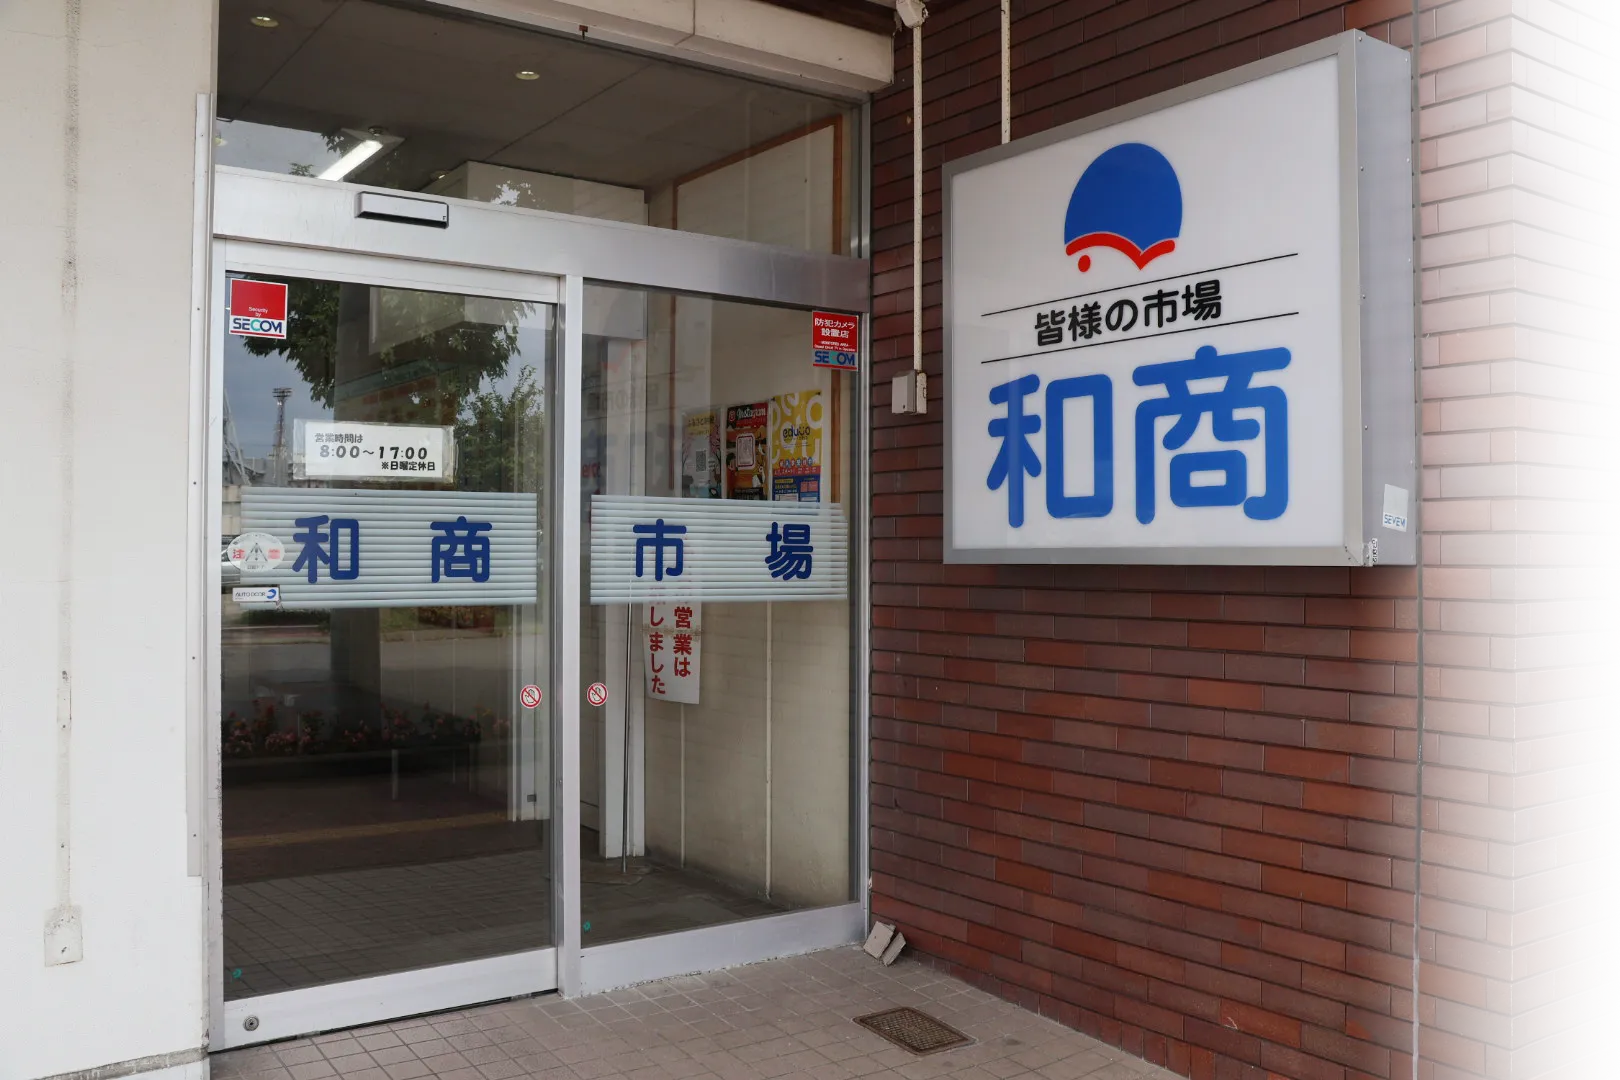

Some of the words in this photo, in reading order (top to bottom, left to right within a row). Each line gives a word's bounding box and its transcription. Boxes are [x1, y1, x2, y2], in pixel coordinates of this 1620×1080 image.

[248, 306, 268, 314] Security
[1034, 279, 1222, 346] 皆様の市場
[233, 317, 282, 334] SECOM
[814, 317, 856, 330] 防犯カメラ
[821, 328, 849, 339] 設置店
[814, 350, 856, 366] SECOM
[314, 432, 363, 444] 営業時間は
[986, 344, 1292, 529] 和商
[649, 598, 666, 695] しました
[673, 600, 693, 678] 営業は
